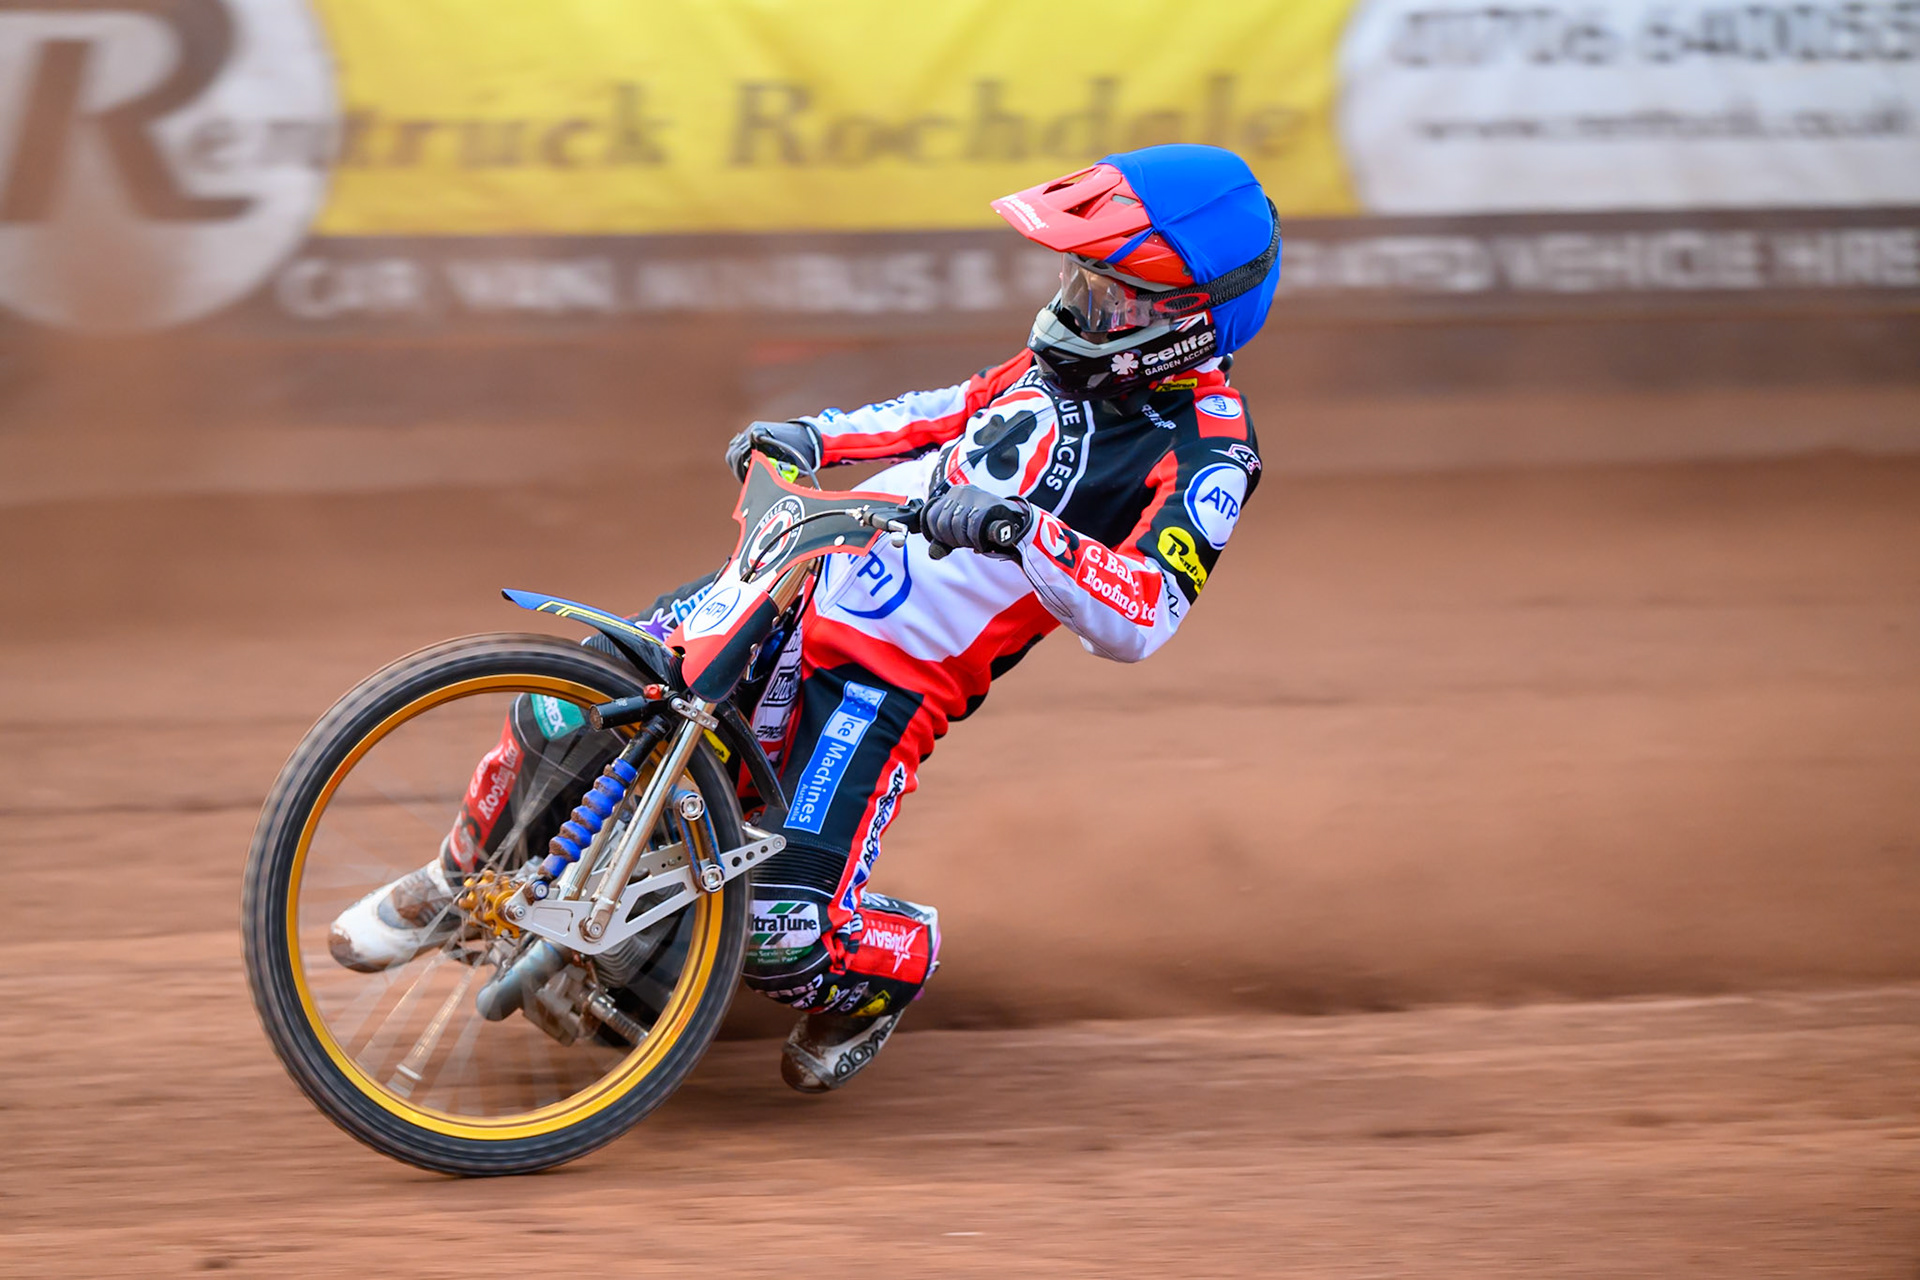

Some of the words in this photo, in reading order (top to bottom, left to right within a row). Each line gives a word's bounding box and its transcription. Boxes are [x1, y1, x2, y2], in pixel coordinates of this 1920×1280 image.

[1144, 359, 1181, 376] GARDEN
[1057, 399, 1081, 426] UE
[1045, 434, 1079, 491] ACES
[1082, 566, 1140, 620] Roofing
[837, 717, 863, 738] Ice
[798, 741, 847, 824] Machines
[749, 913, 817, 931] ltraTune
